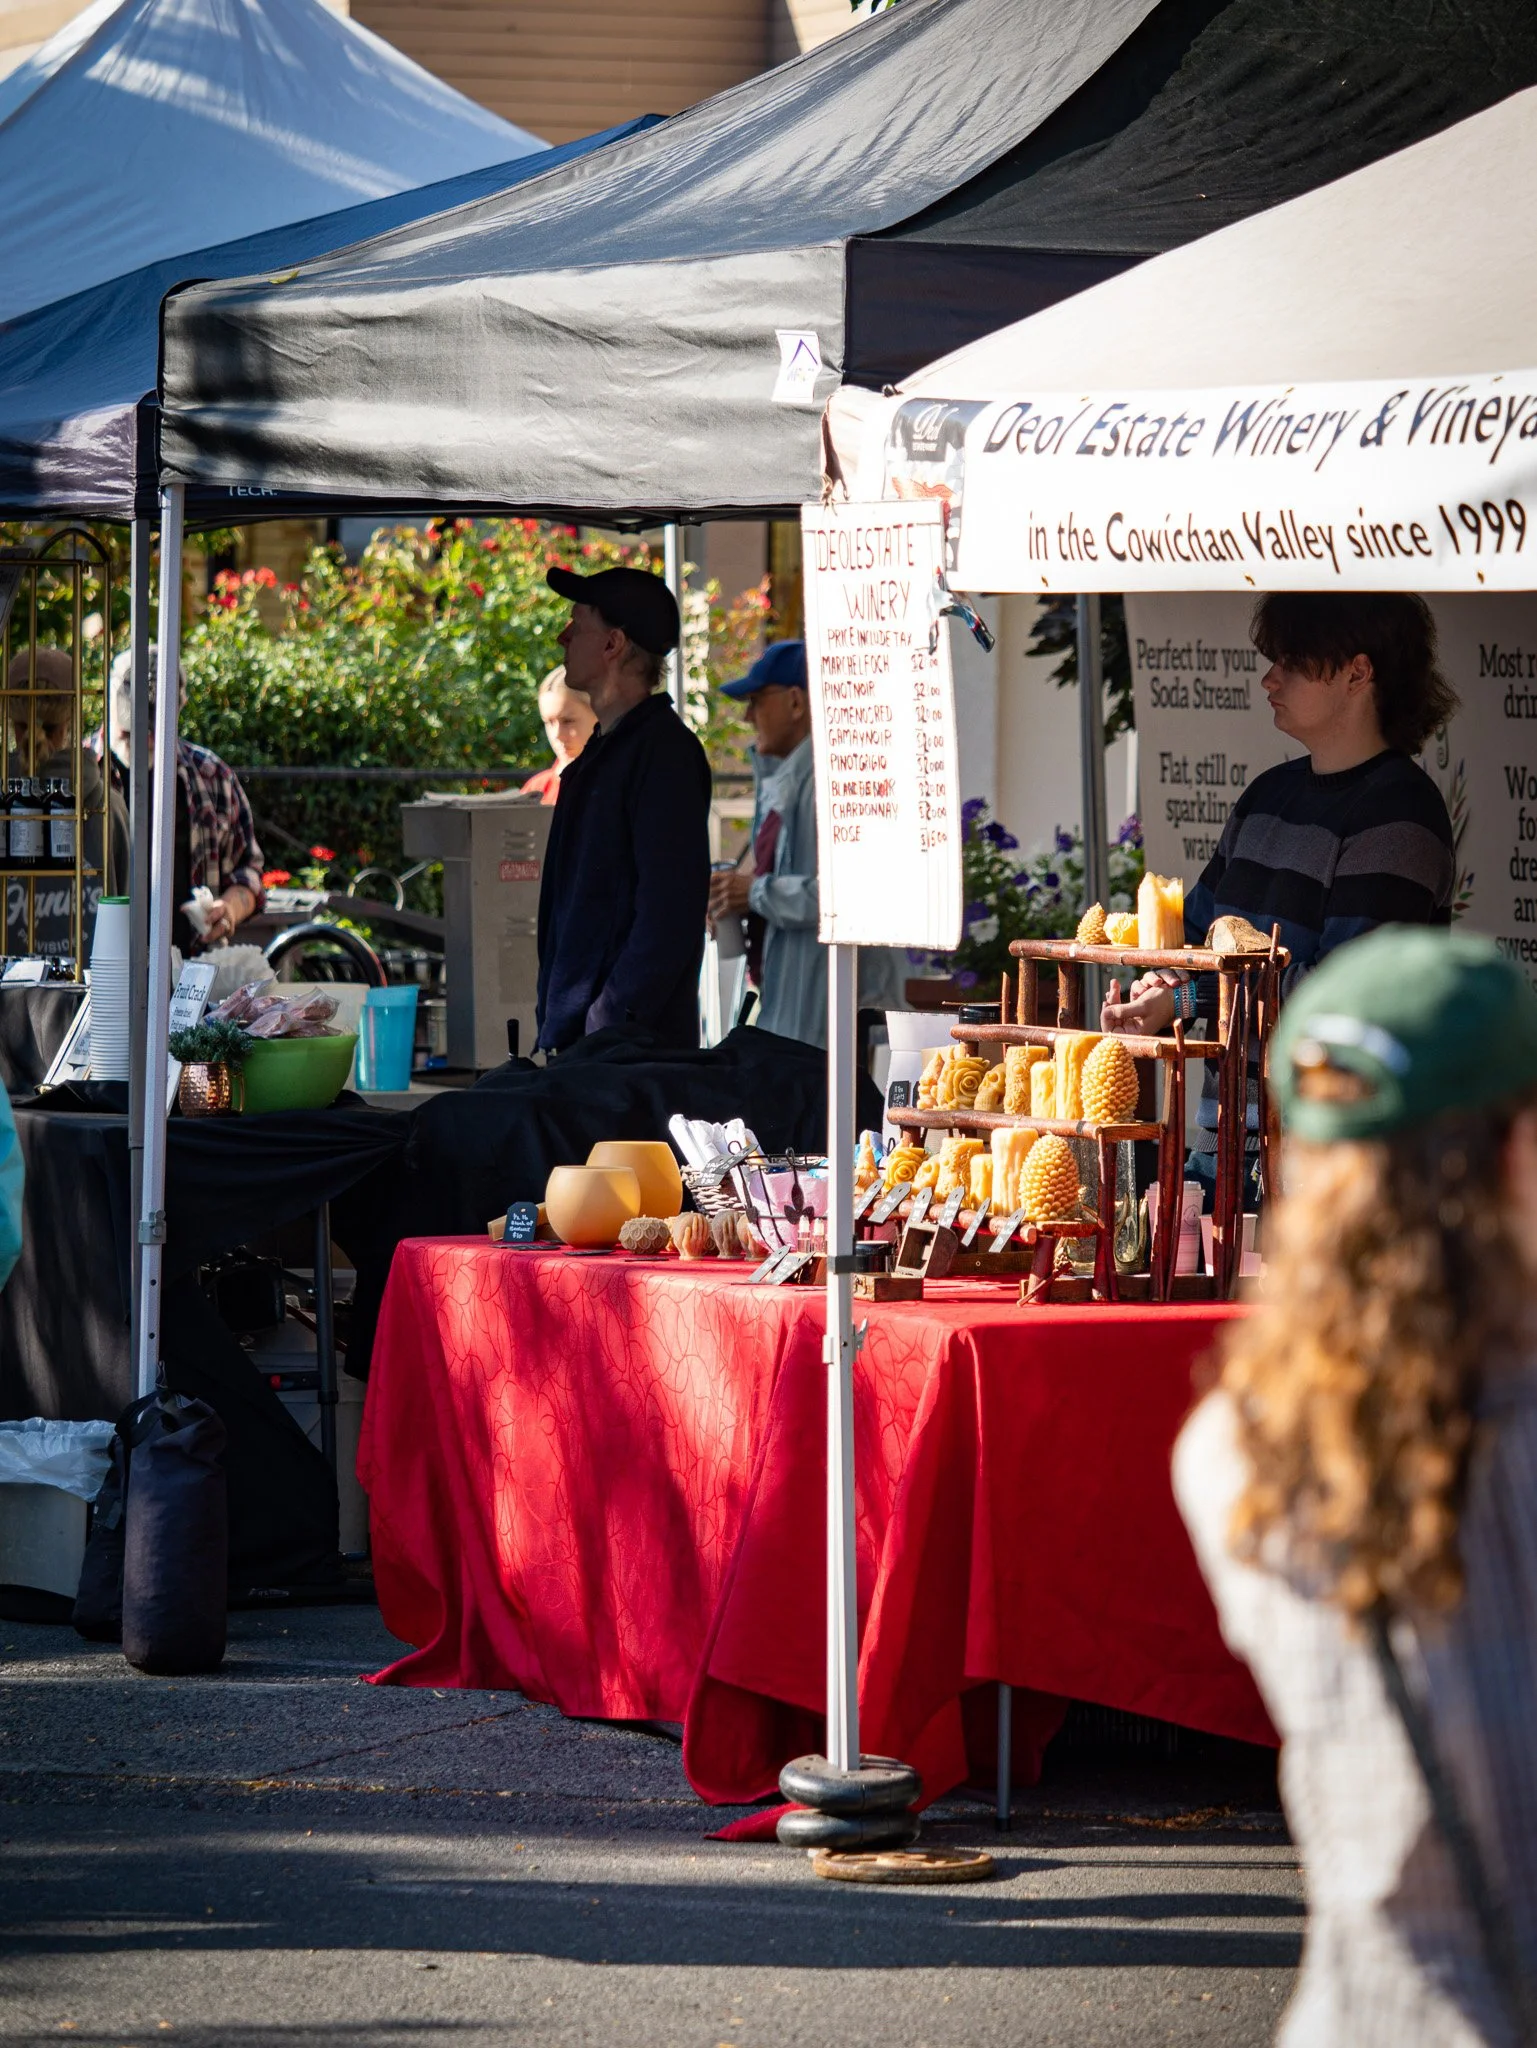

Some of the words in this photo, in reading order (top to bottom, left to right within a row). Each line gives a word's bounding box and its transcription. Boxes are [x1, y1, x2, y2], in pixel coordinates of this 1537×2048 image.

[983, 402, 1094, 455] Deol
[1076, 403, 1205, 458] Estate
[1212, 398, 1361, 472] Winery
[1360, 390, 1410, 448] &
[1407, 385, 1537, 465] Vineya
[1029, 511, 1049, 561] in
[1058, 512, 1098, 562] the
[1106, 511, 1244, 563] Cowichan
[1242, 509, 1341, 574] Valley
[1347, 507, 1432, 558] since
[1438, 499, 1527, 556] 1999
[843, 580, 910, 621] WINERY
[1136, 639, 1194, 672] Perfect
[1196, 640, 1218, 671] for
[1221, 649, 1257, 678] your
[1479, 643, 1523, 678] Most
[1150, 677, 1189, 709] Soda
[1193, 678, 1250, 711] Stream!
[1160, 752, 1192, 789] Flat,
[1196, 753, 1226, 786] still
[1231, 763, 1248, 787] or
[832, 802, 898, 820] CHARDONNAY
[1166, 791, 1236, 829] sparklin
[1518, 807, 1537, 841] fo
[833, 825, 861, 845] ROSE
